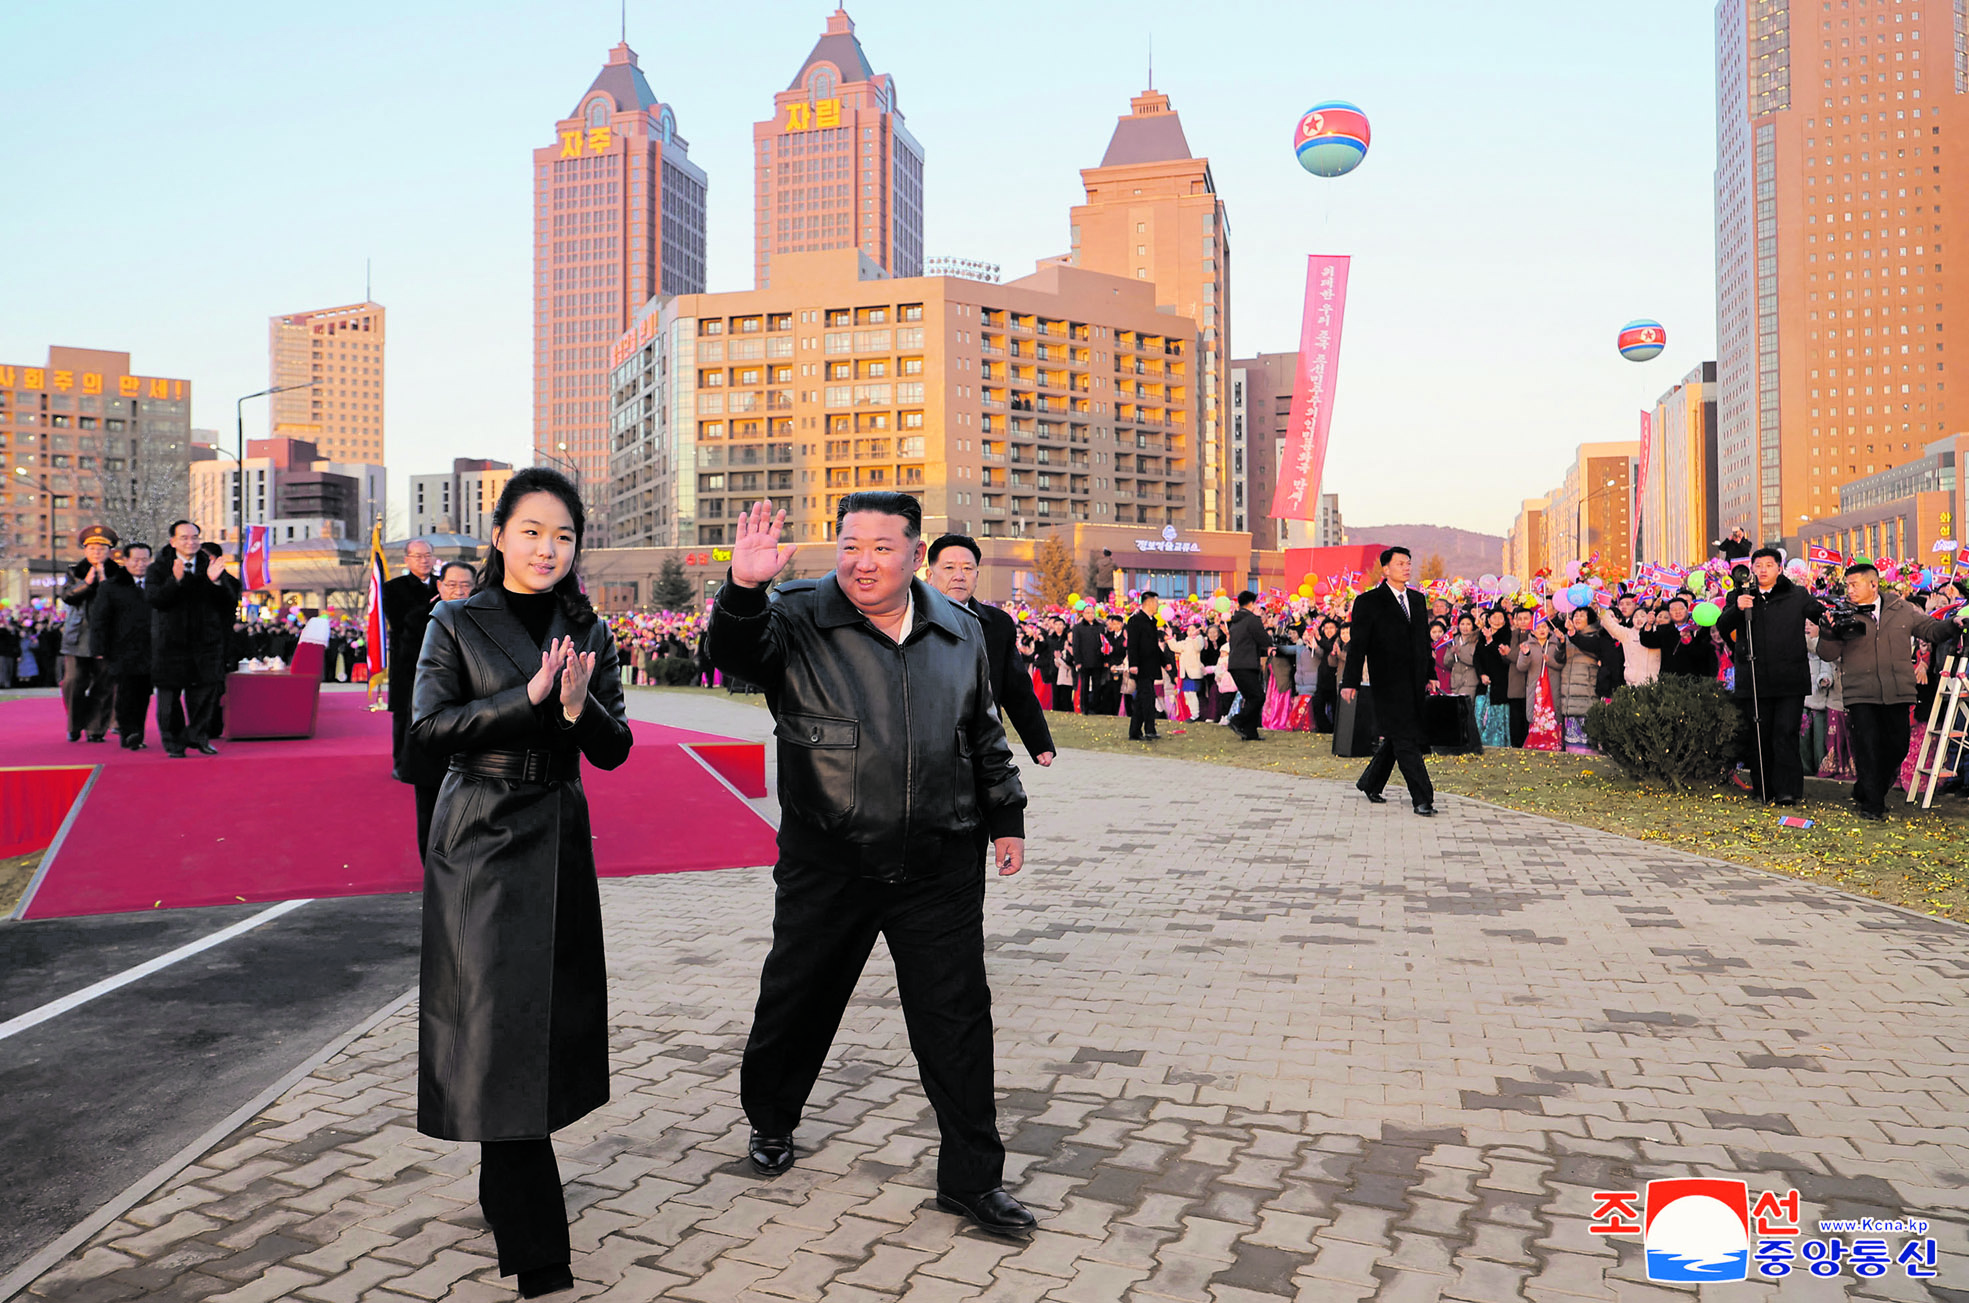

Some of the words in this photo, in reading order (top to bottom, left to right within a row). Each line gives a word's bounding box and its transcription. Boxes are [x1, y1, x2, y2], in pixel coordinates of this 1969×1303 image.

[785, 98, 840, 131] 자립
[560, 127, 611, 158] 자주
[1320, 265, 1336, 300] 위대한
[1317, 303, 1333, 326] 우리
[1314, 330, 1331, 350] 조국
[0, 365, 103, 395] 사회주의
[118, 375, 183, 400] 만세!
[1287, 478, 1308, 511] 만세!
